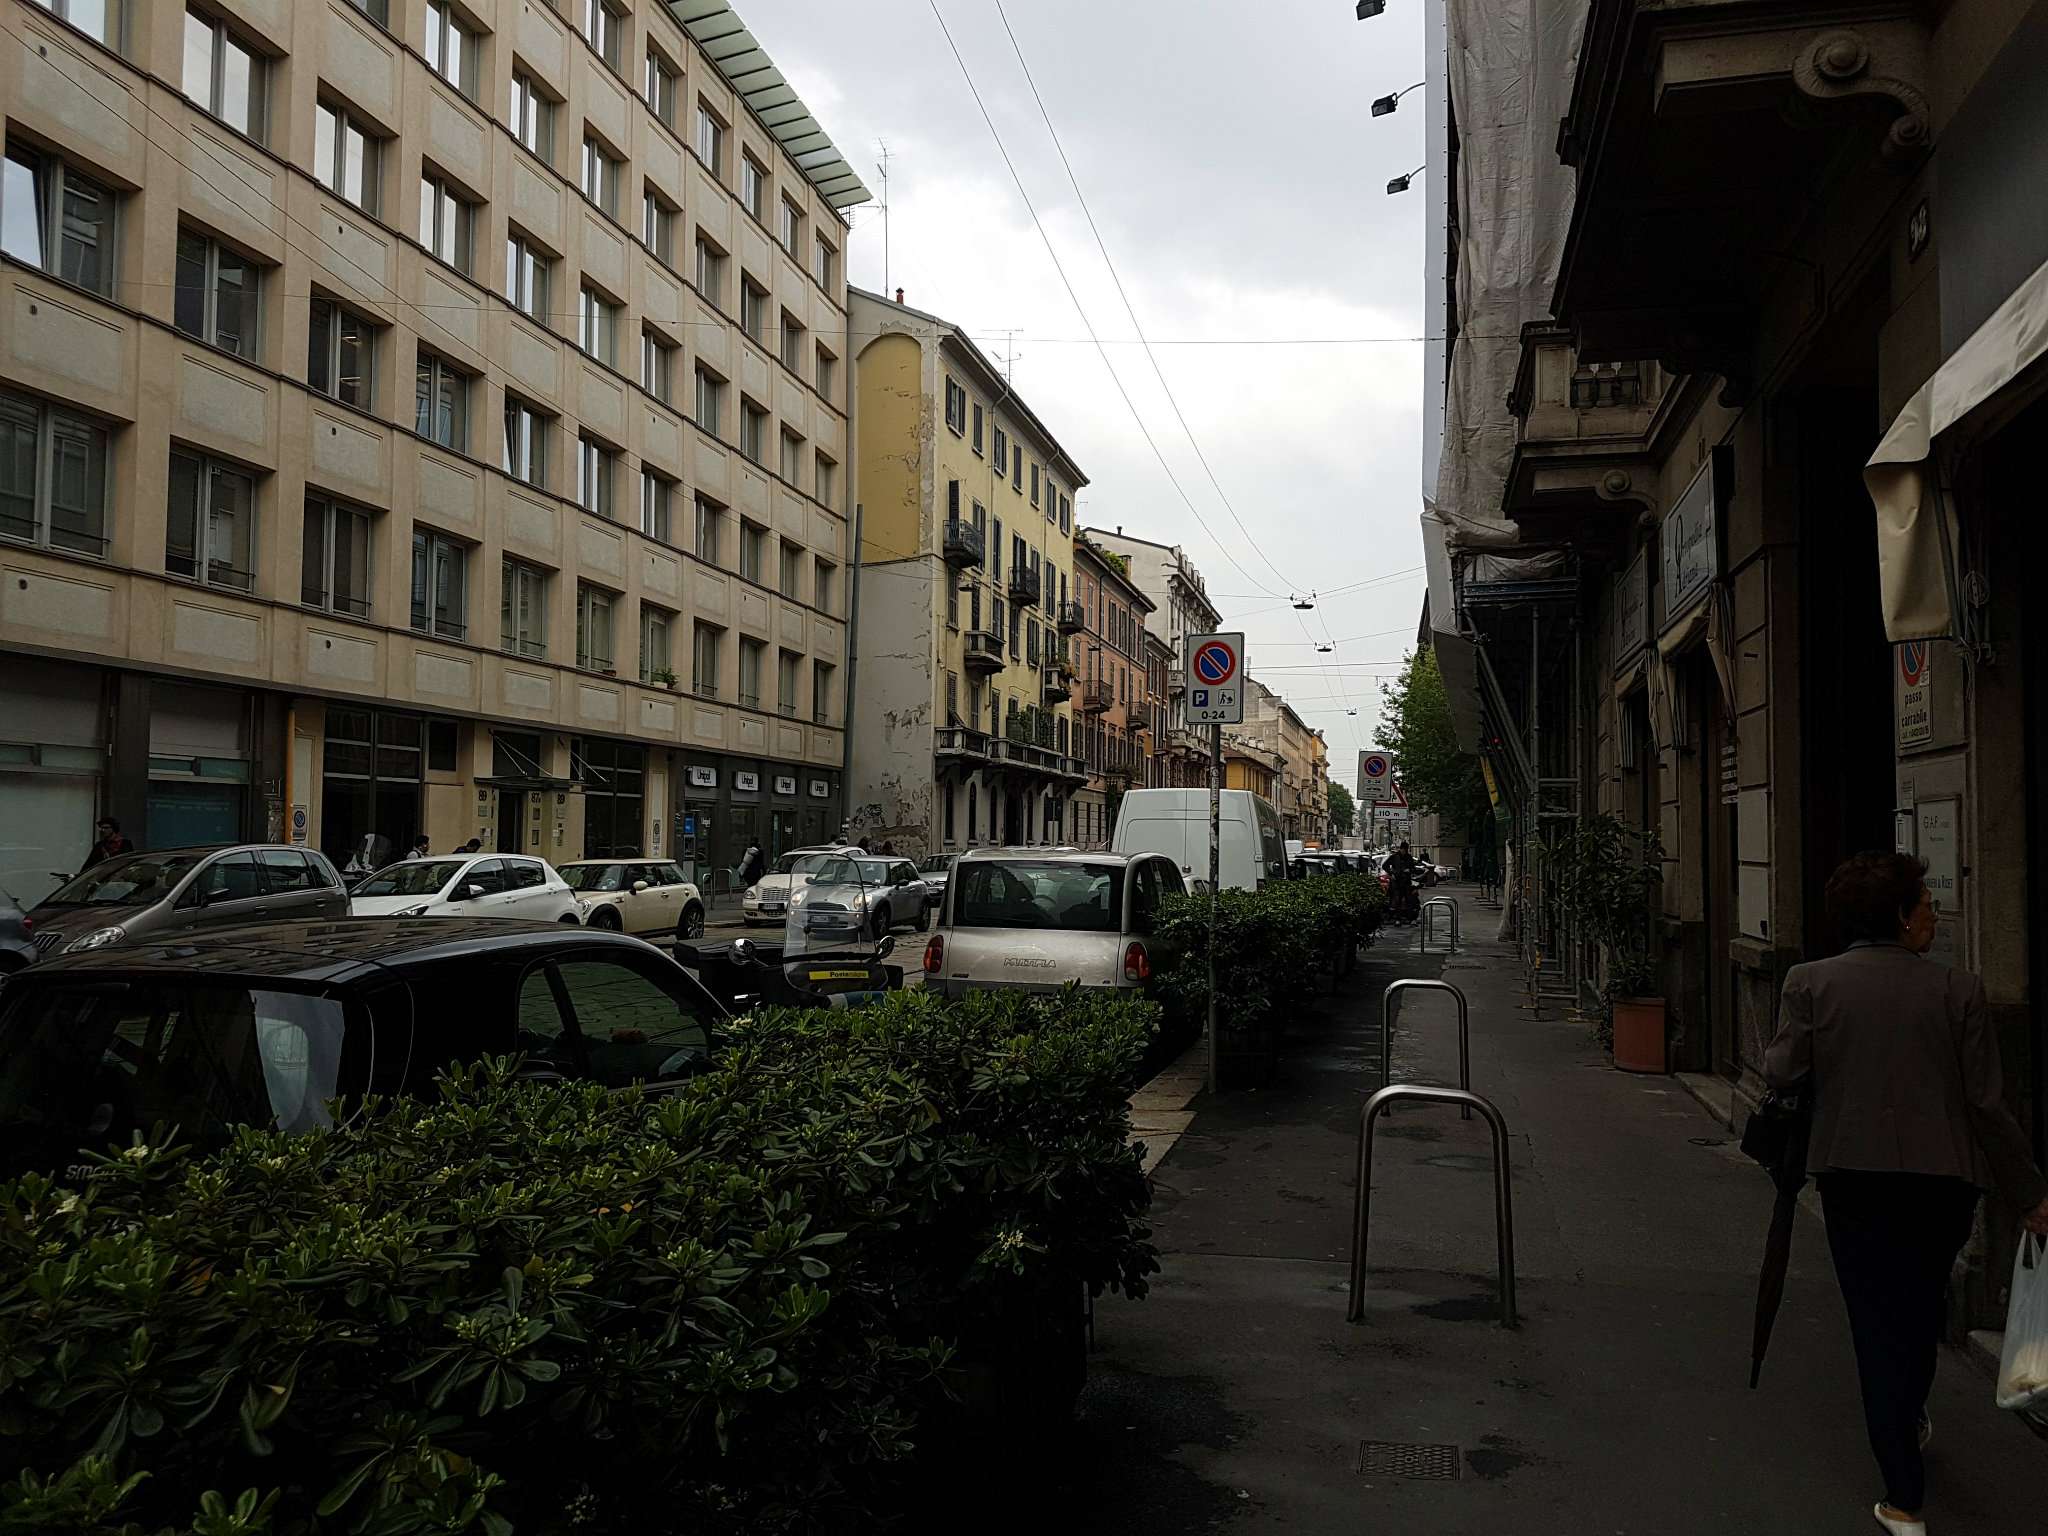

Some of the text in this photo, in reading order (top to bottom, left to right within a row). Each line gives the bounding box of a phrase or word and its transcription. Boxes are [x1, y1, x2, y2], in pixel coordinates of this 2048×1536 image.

[1196, 692, 1205, 705] P
[1905, 689, 1922, 707] passo
[1201, 710, 1226, 720] 0-24
[1902, 709, 1927, 727] carrabile
[1003, 957, 1057, 968] MULTIPLA
